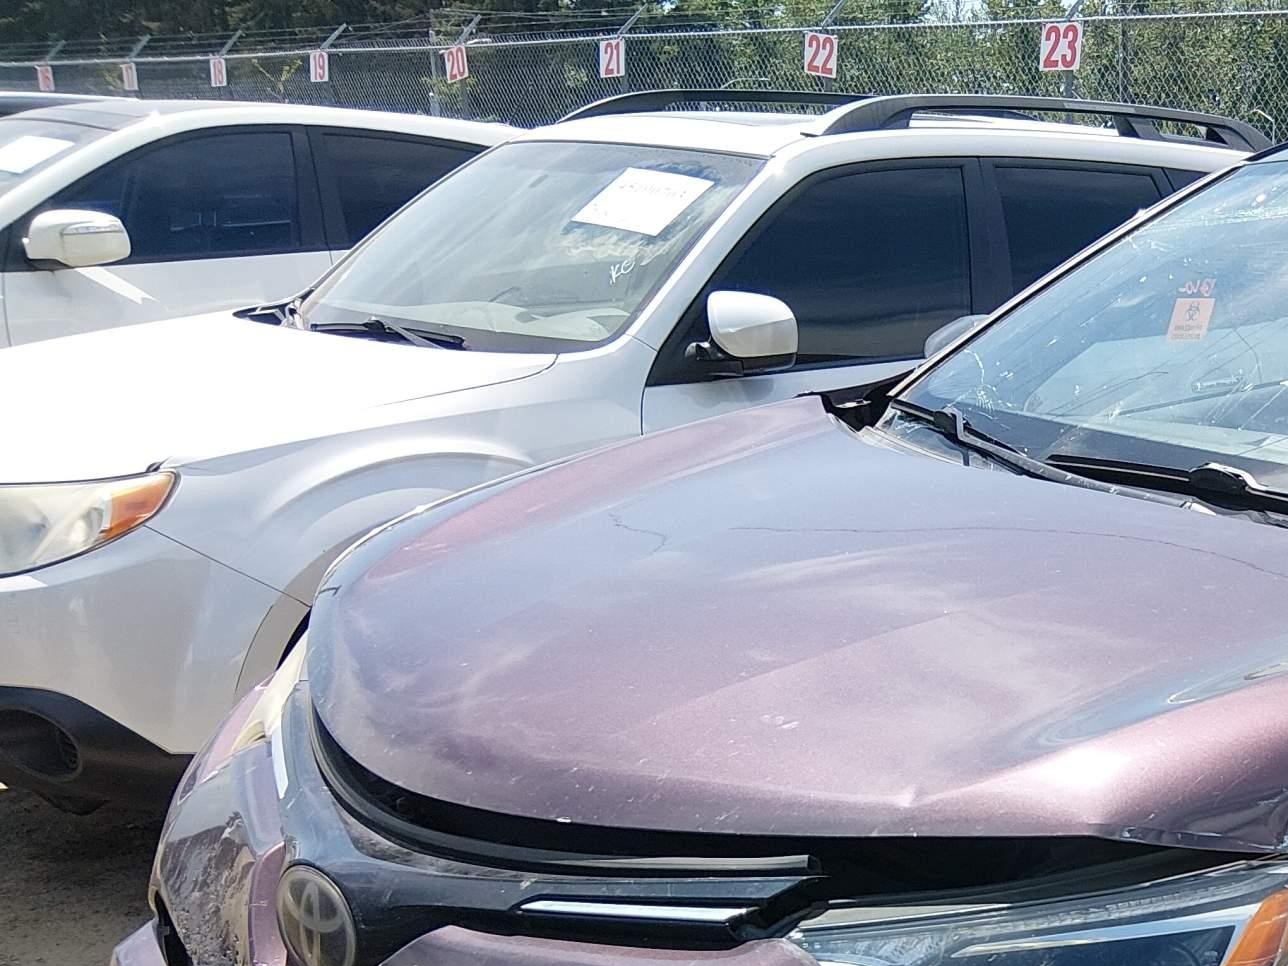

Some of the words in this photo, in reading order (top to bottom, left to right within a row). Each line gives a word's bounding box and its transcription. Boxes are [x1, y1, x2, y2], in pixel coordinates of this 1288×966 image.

[447, 46, 466, 81] 20
[604, 41, 621, 76] 21
[806, 34, 835, 76] 22
[1043, 24, 1078, 68] 23
[313, 52, 326, 81] 19
